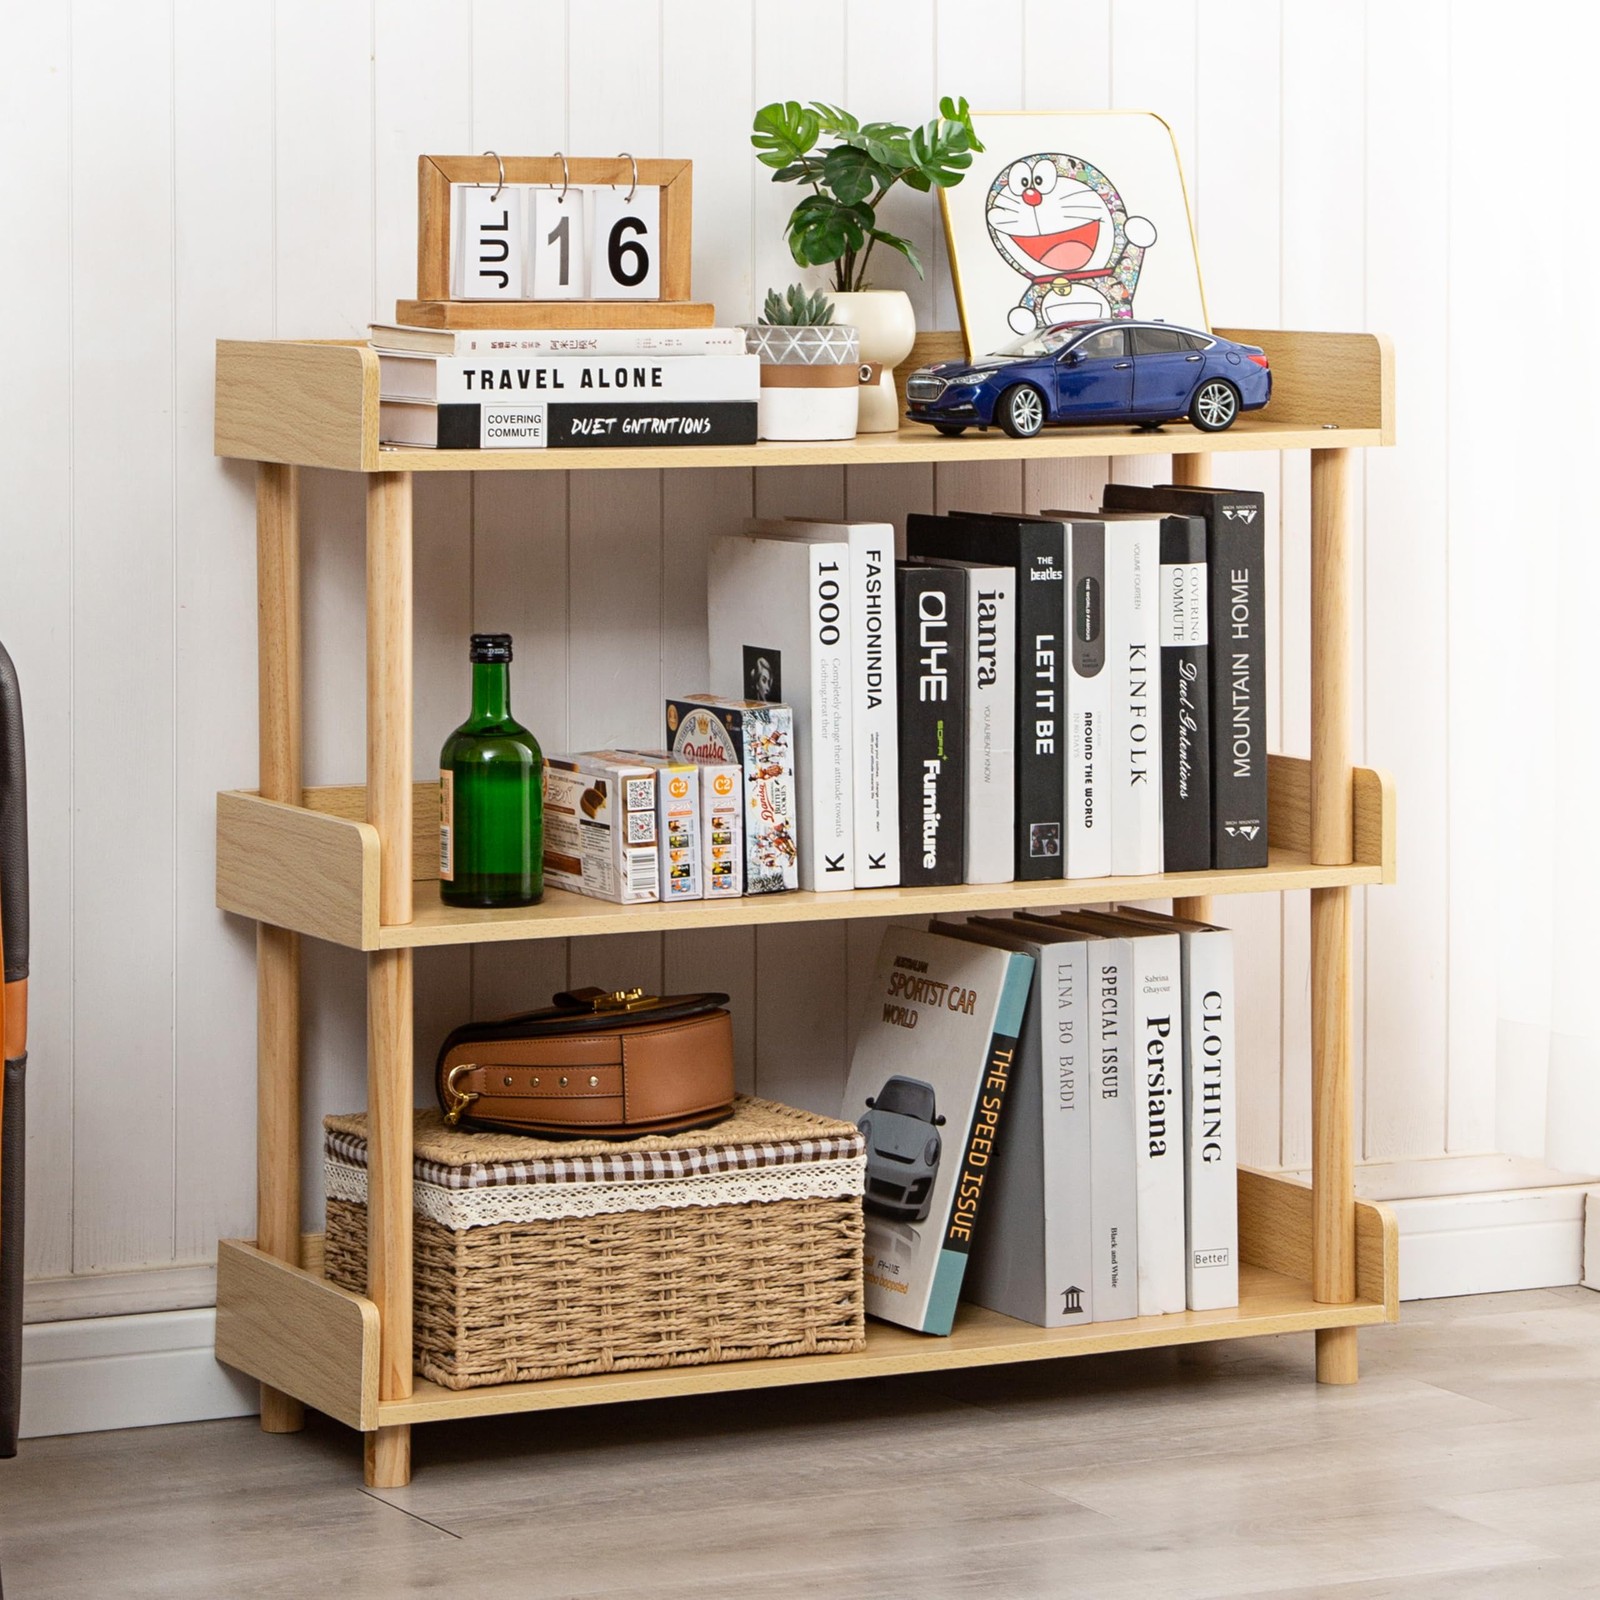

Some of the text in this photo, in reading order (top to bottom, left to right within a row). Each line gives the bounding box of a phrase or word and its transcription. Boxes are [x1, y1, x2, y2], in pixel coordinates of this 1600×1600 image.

[479, 210, 650, 289] JUL 1 6
[463, 367, 662, 390] TRAVEL ALONE
[487, 415, 542, 424] COVERING
[487, 428, 540, 437] COMMUTE
[571, 418, 617, 435] DUET
[1037, 556, 1053, 564] THE
[818, 561, 840, 646] 1000
[1134, 574, 1142, 610] FOURTEEN
[1173, 567, 1184, 642] COMMUTE
[1190, 567, 1200, 642] COVERING
[866, 550, 882, 710] FASHIONINDIA
[977, 589, 1004, 690] ianra
[1035, 634, 1055, 755] LET IT BE
[1179, 659, 1197, 710] Duel
[1231, 568, 1251, 778] MOUNTAIN HOME
[820, 719, 830, 739] their
[1084, 712, 1092, 760] AROUND
[1129, 643, 1148, 787] KINFOLK
[831, 658, 844, 838] Completely change their attitude towards
[670, 782, 686, 794] C2
[715, 779, 730, 790] C2
[757, 783, 774, 822] Danisa
[1085, 788, 1093, 828] WORLD
[923, 760, 941, 870] Furniture
[825, 853, 845, 873] K
[868, 853, 886, 870] K
[888, 972, 977, 1015] SPORTST CAR
[1144, 975, 1168, 983] Sabrina
[882, 1003, 918, 1029] WORLD
[1058, 963, 1074, 1112] LINA BO BARDI
[1102, 966, 1118, 1100] SPECIAL ISSUE
[1146, 1016, 1172, 1158] Persiana
[1202, 990, 1222, 1164] CLOTHING
[950, 1049, 1014, 1242] THE SPEED ISSUE
[1110, 1227, 1118, 1288] Black and White
[1195, 1254, 1227, 1264] Better
